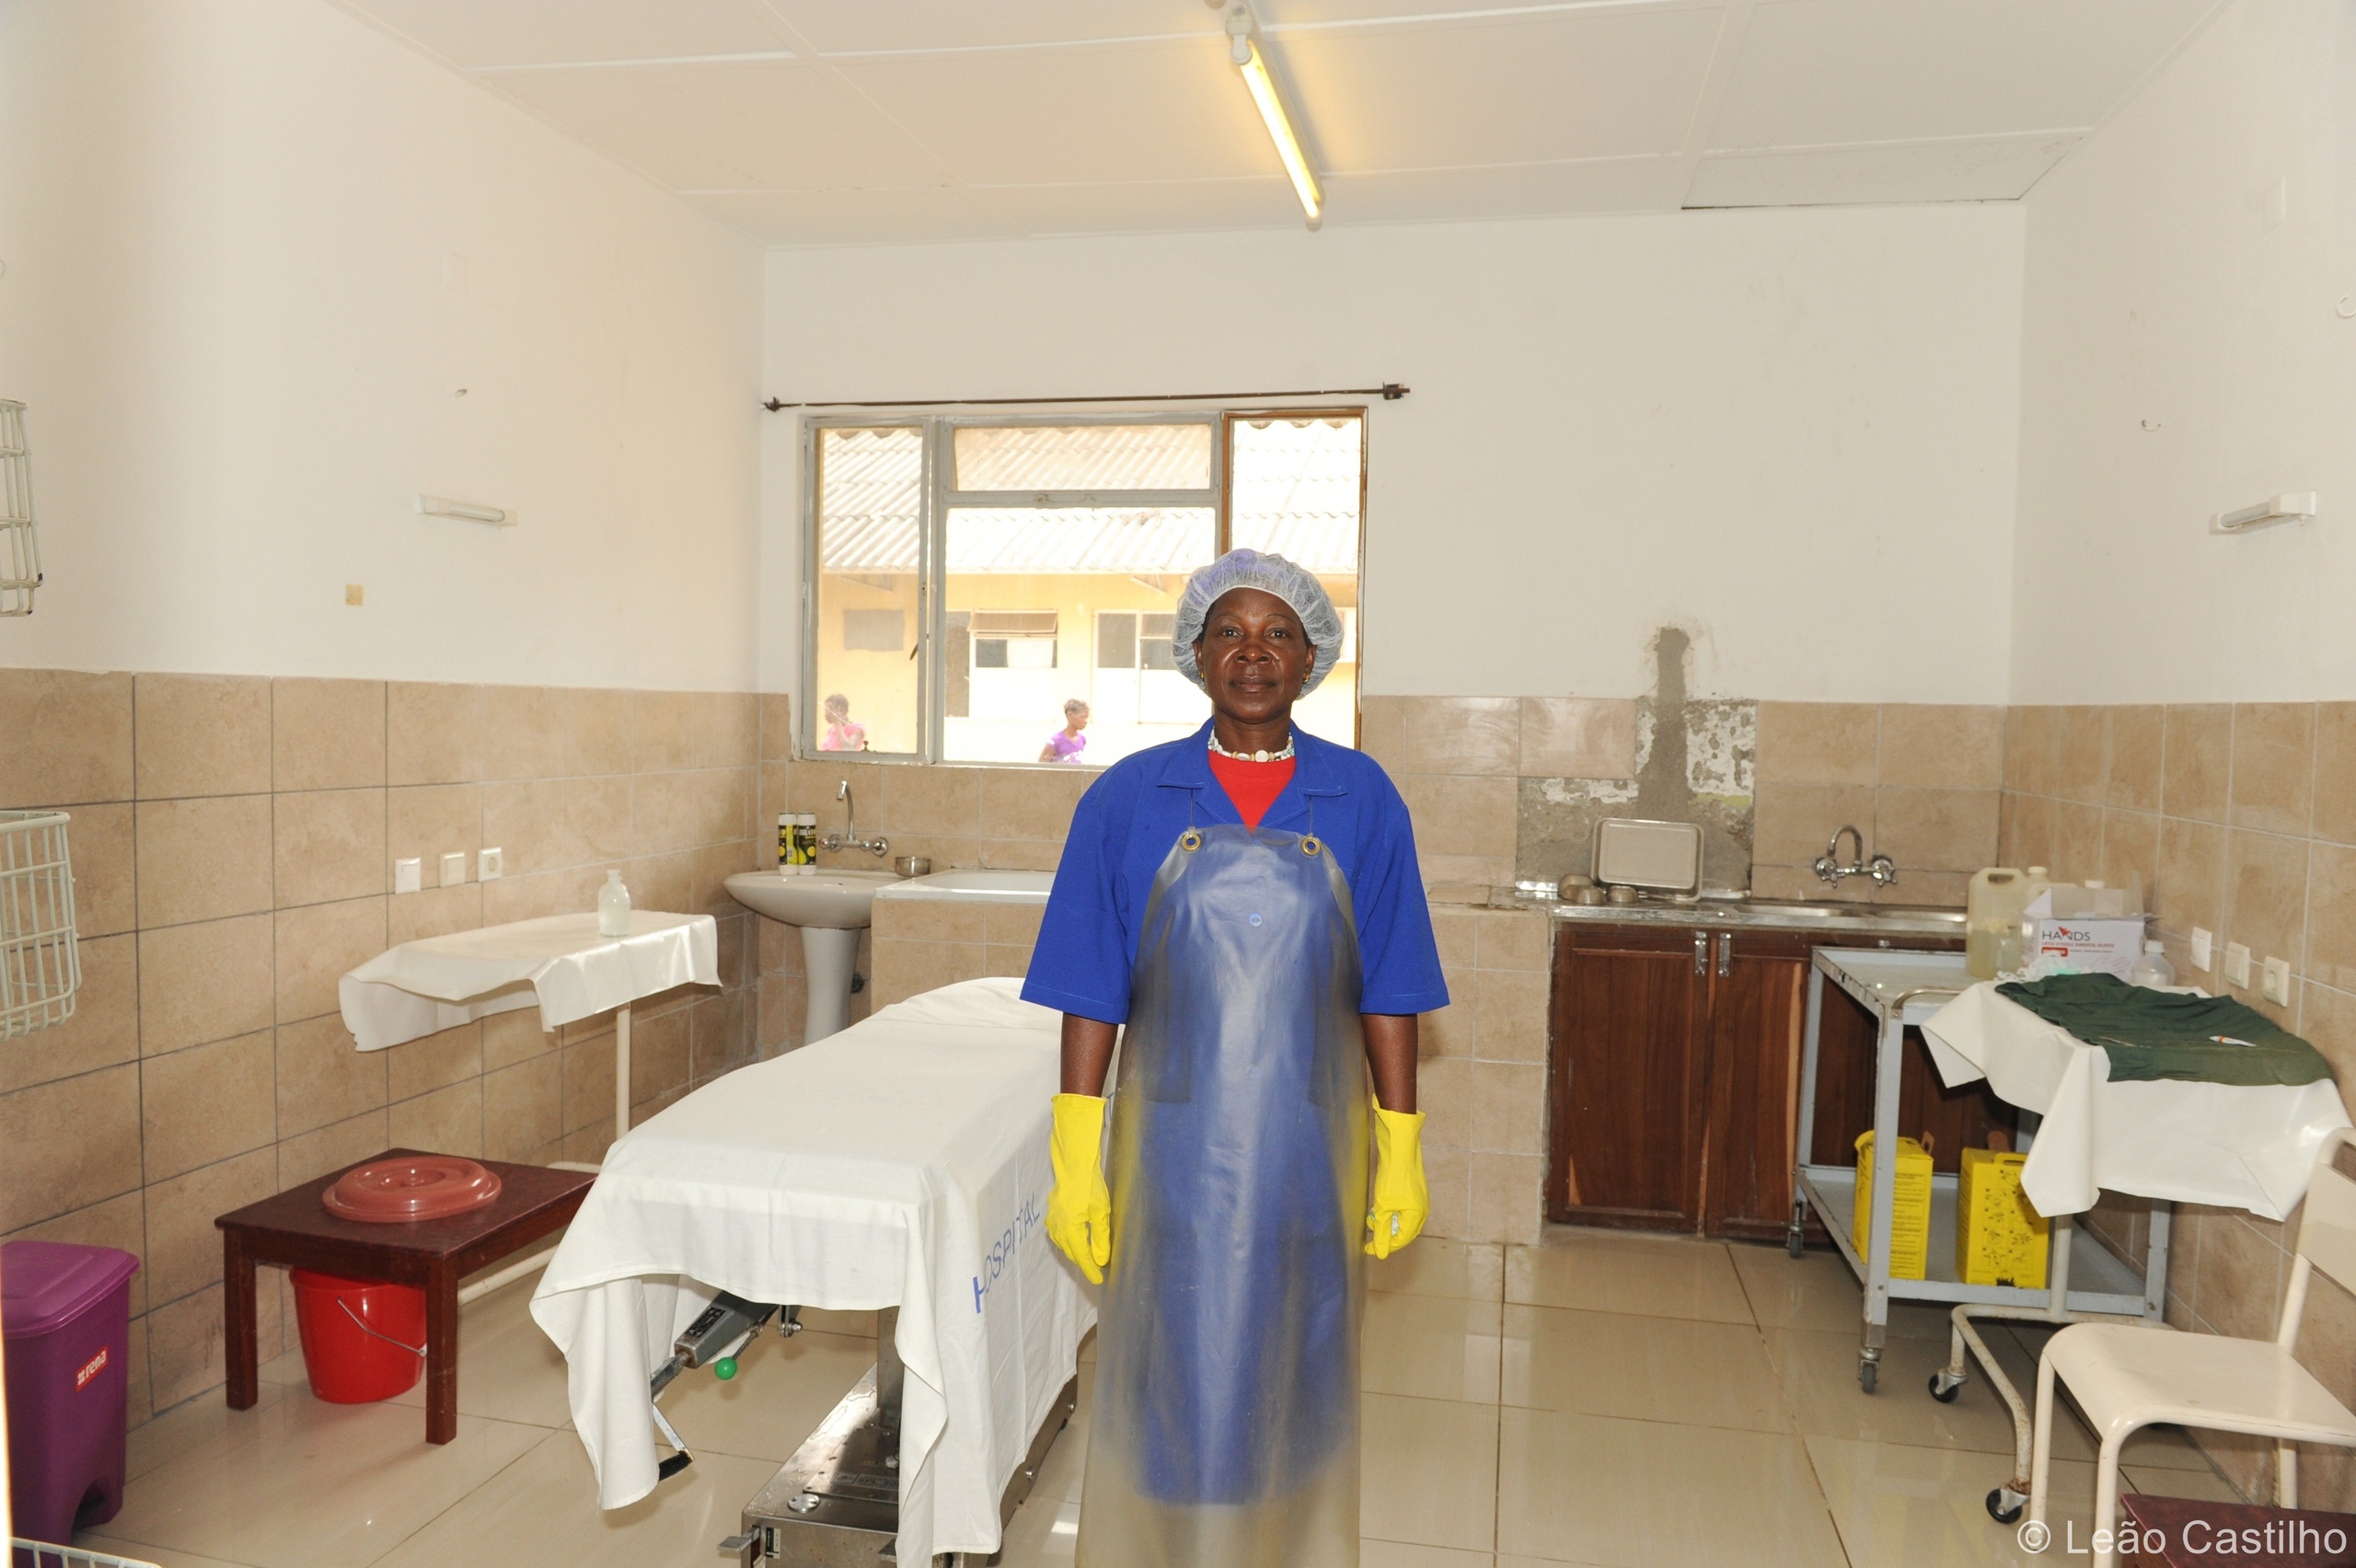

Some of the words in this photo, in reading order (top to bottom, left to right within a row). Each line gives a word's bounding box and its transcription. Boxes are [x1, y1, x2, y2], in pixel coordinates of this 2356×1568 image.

[2041, 930, 2091, 941] HANDS
[973, 1191, 1040, 1314] HOSPITAL
[86, 1350, 107, 1378] rena
